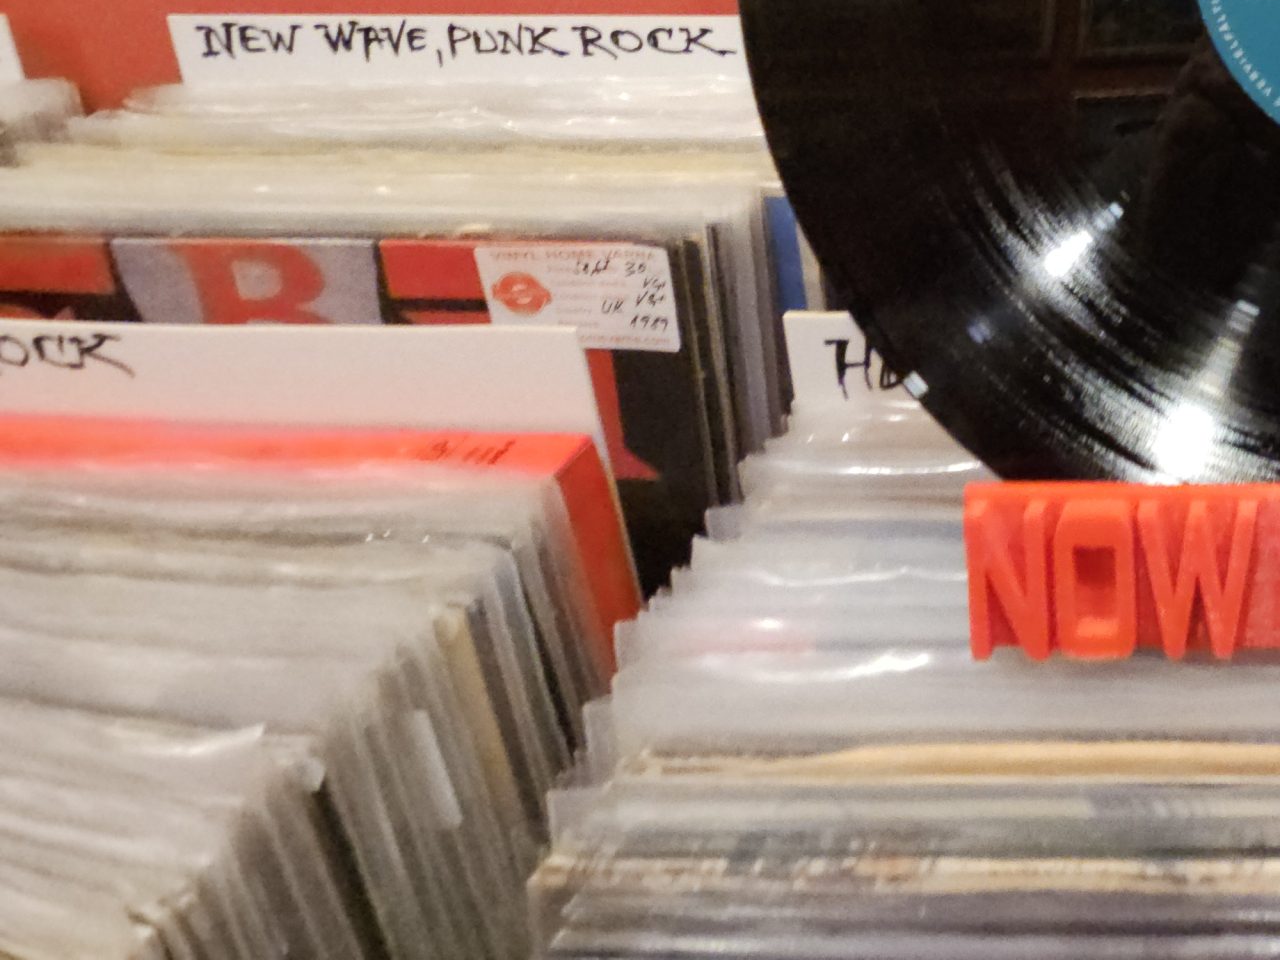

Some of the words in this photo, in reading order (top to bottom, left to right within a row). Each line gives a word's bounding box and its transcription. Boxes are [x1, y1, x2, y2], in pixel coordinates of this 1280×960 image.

[194, 22, 302, 59] NEW
[571, 25, 738, 60] ROCK
[964, 495, 1260, 662] NOW
